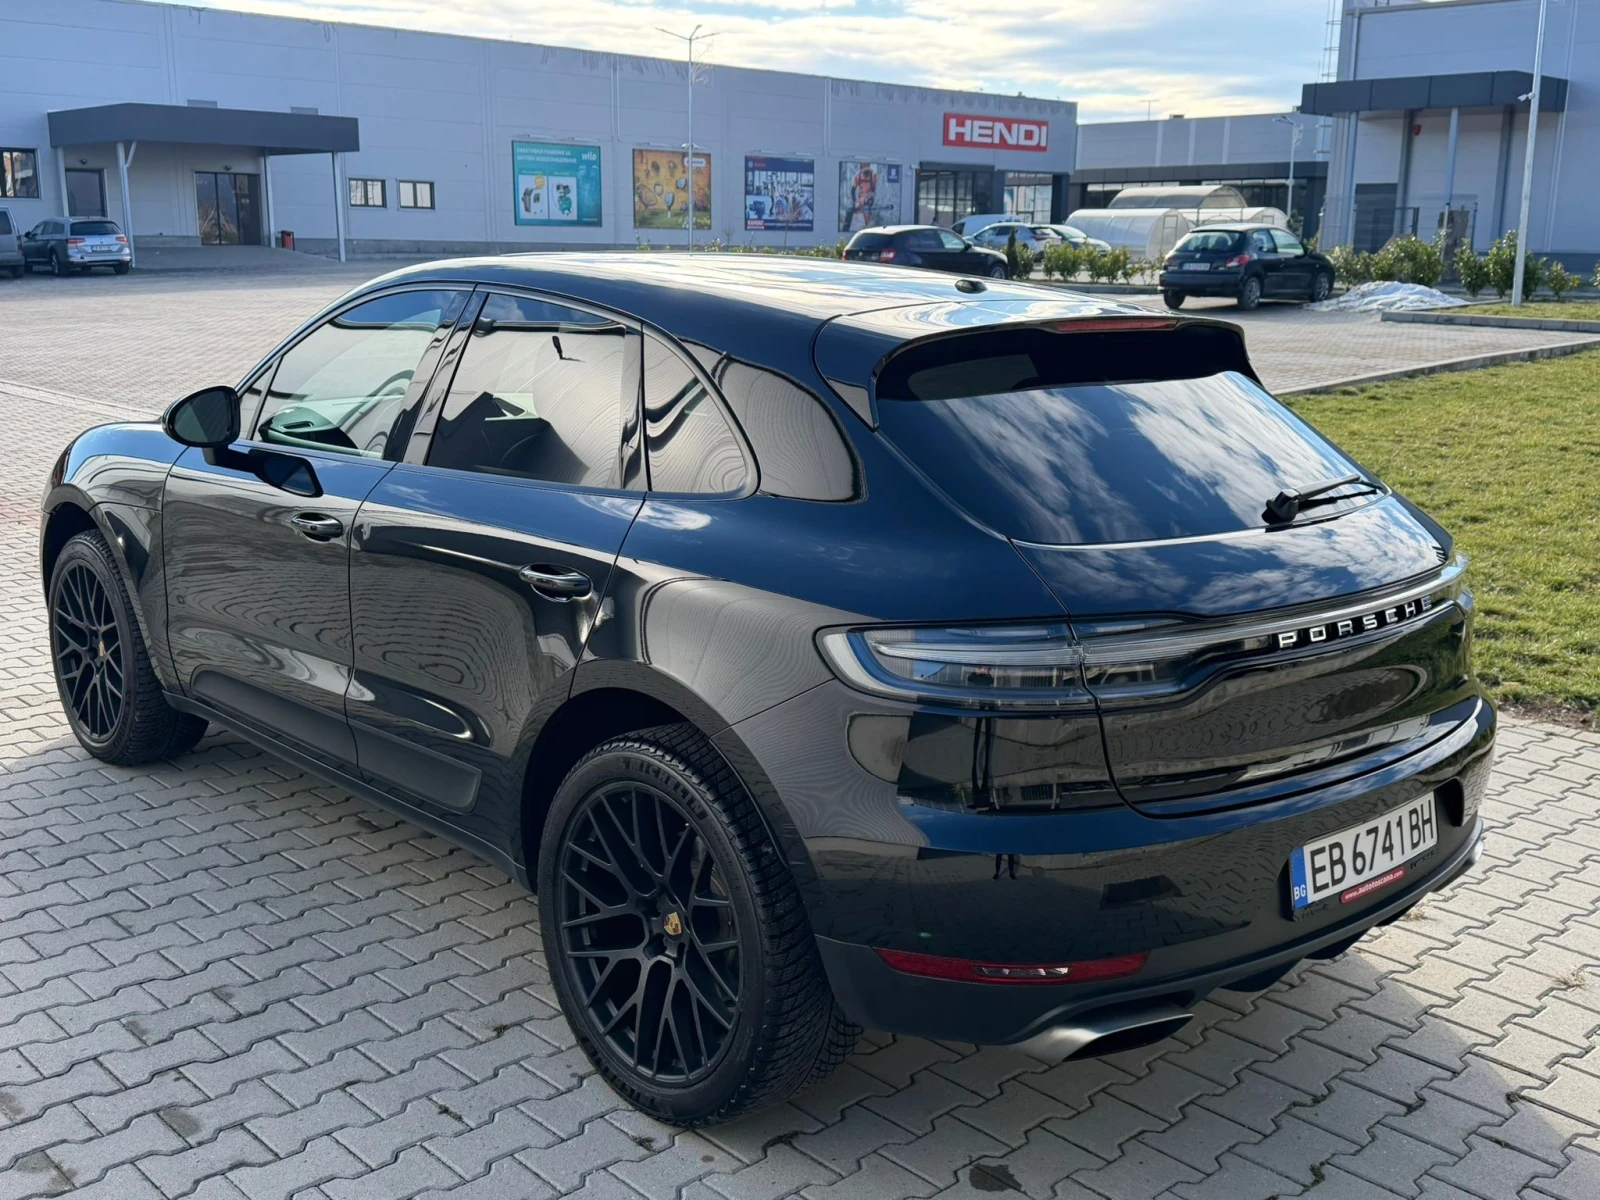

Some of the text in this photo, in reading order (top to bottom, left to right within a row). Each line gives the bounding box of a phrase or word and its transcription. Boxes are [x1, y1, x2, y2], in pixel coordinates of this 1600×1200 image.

[948, 118, 1048, 147] HENDI
[581, 151, 597, 161] wilo
[1278, 596, 1433, 648] PORSCHE
[629, 758, 705, 819] MICHELIN
[1309, 800, 1434, 894] EB 6741 BH
[1293, 884, 1306, 900] BG
